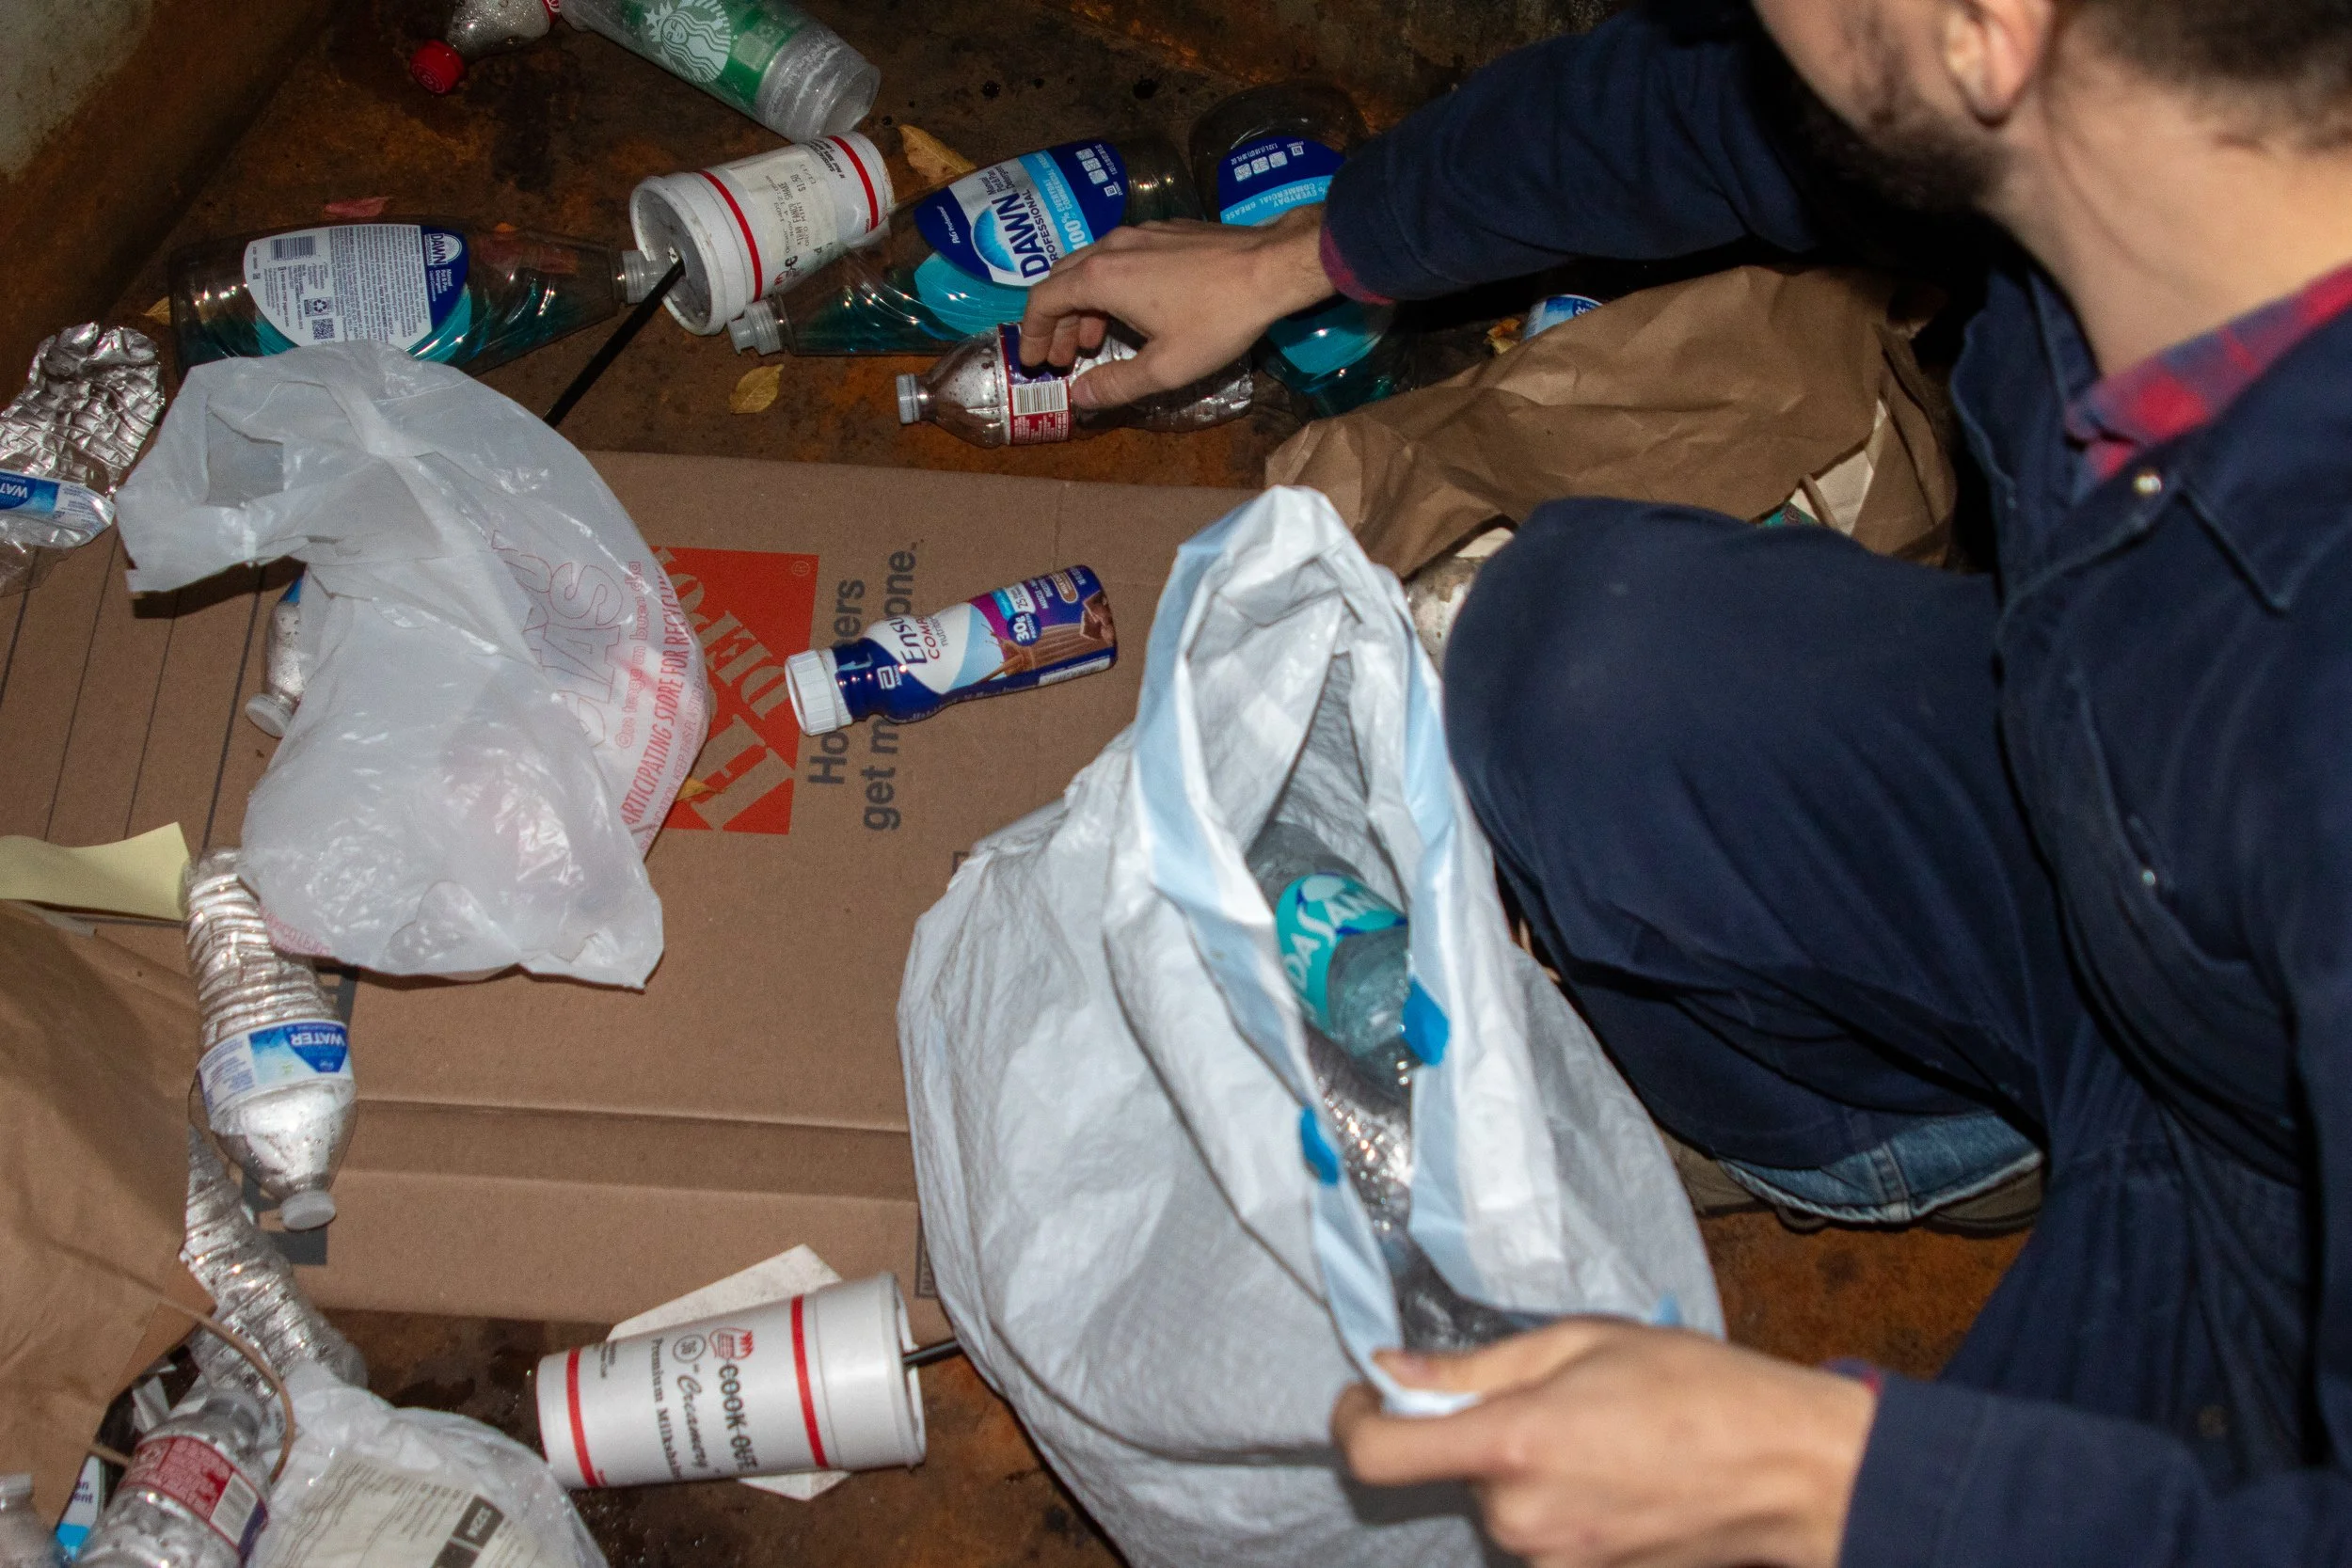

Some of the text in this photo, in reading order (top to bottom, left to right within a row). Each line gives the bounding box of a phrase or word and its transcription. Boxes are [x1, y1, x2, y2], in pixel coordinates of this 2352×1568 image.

[1225, 201, 1256, 221] GREASE
[1259, 182, 1315, 204] COMMERCIAL
[1273, 189, 1317, 208] EVERYDAY
[430, 233, 446, 264] DAWN
[992, 192, 1051, 278] DAWN
[1022, 189, 1059, 262] ROFESSIONAL
[434, 269, 442, 293] Detergent
[0, 482, 28, 498] WAT
[651, 546, 789, 720] DEPO
[888, 616, 927, 664] Ensu
[922, 614, 940, 660] COMP
[1012, 614, 1032, 641] 30g
[1025, 613, 1037, 639] PROTEIN
[620, 566, 690, 824] ARTICIPATING STORE FOR RECYCLIN
[807, 731, 848, 784] Ho
[861, 766, 900, 832] get
[290, 1032, 344, 1047] WATER
[651, 1337, 681, 1482] Premium Milkshake
[720, 1364, 756, 1469] COOK OUT
